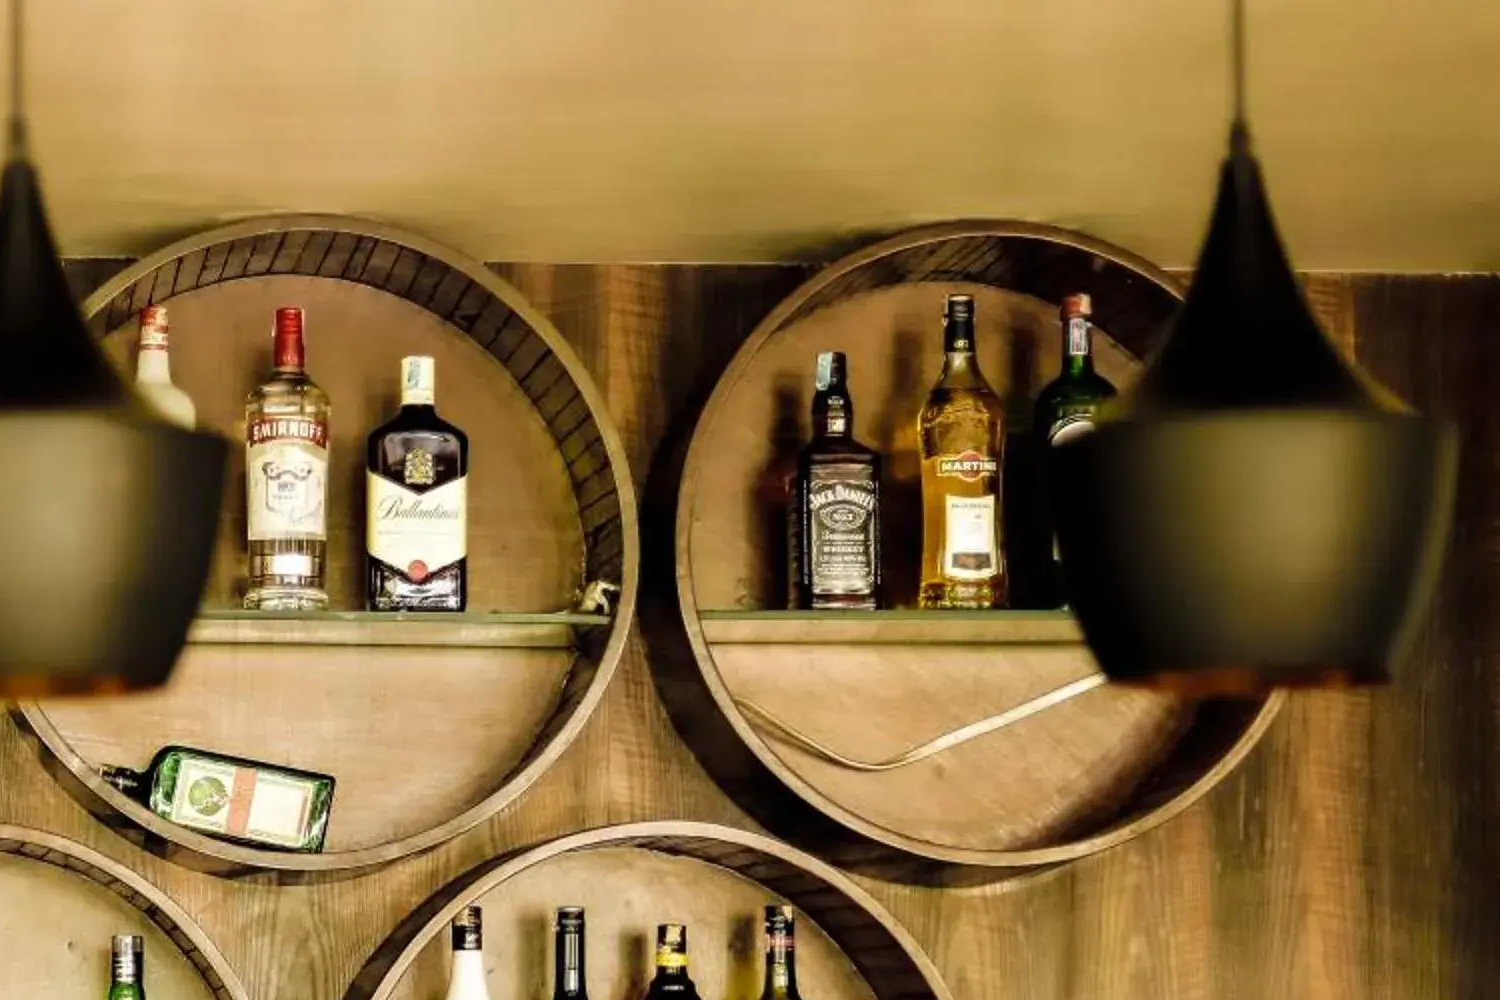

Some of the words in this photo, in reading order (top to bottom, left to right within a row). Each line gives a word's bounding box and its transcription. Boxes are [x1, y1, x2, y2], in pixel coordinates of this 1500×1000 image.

[252, 420, 324, 441] SMIRNOFF
[941, 461, 997, 472] MARTINI
[378, 494, 459, 520] Ballantin
